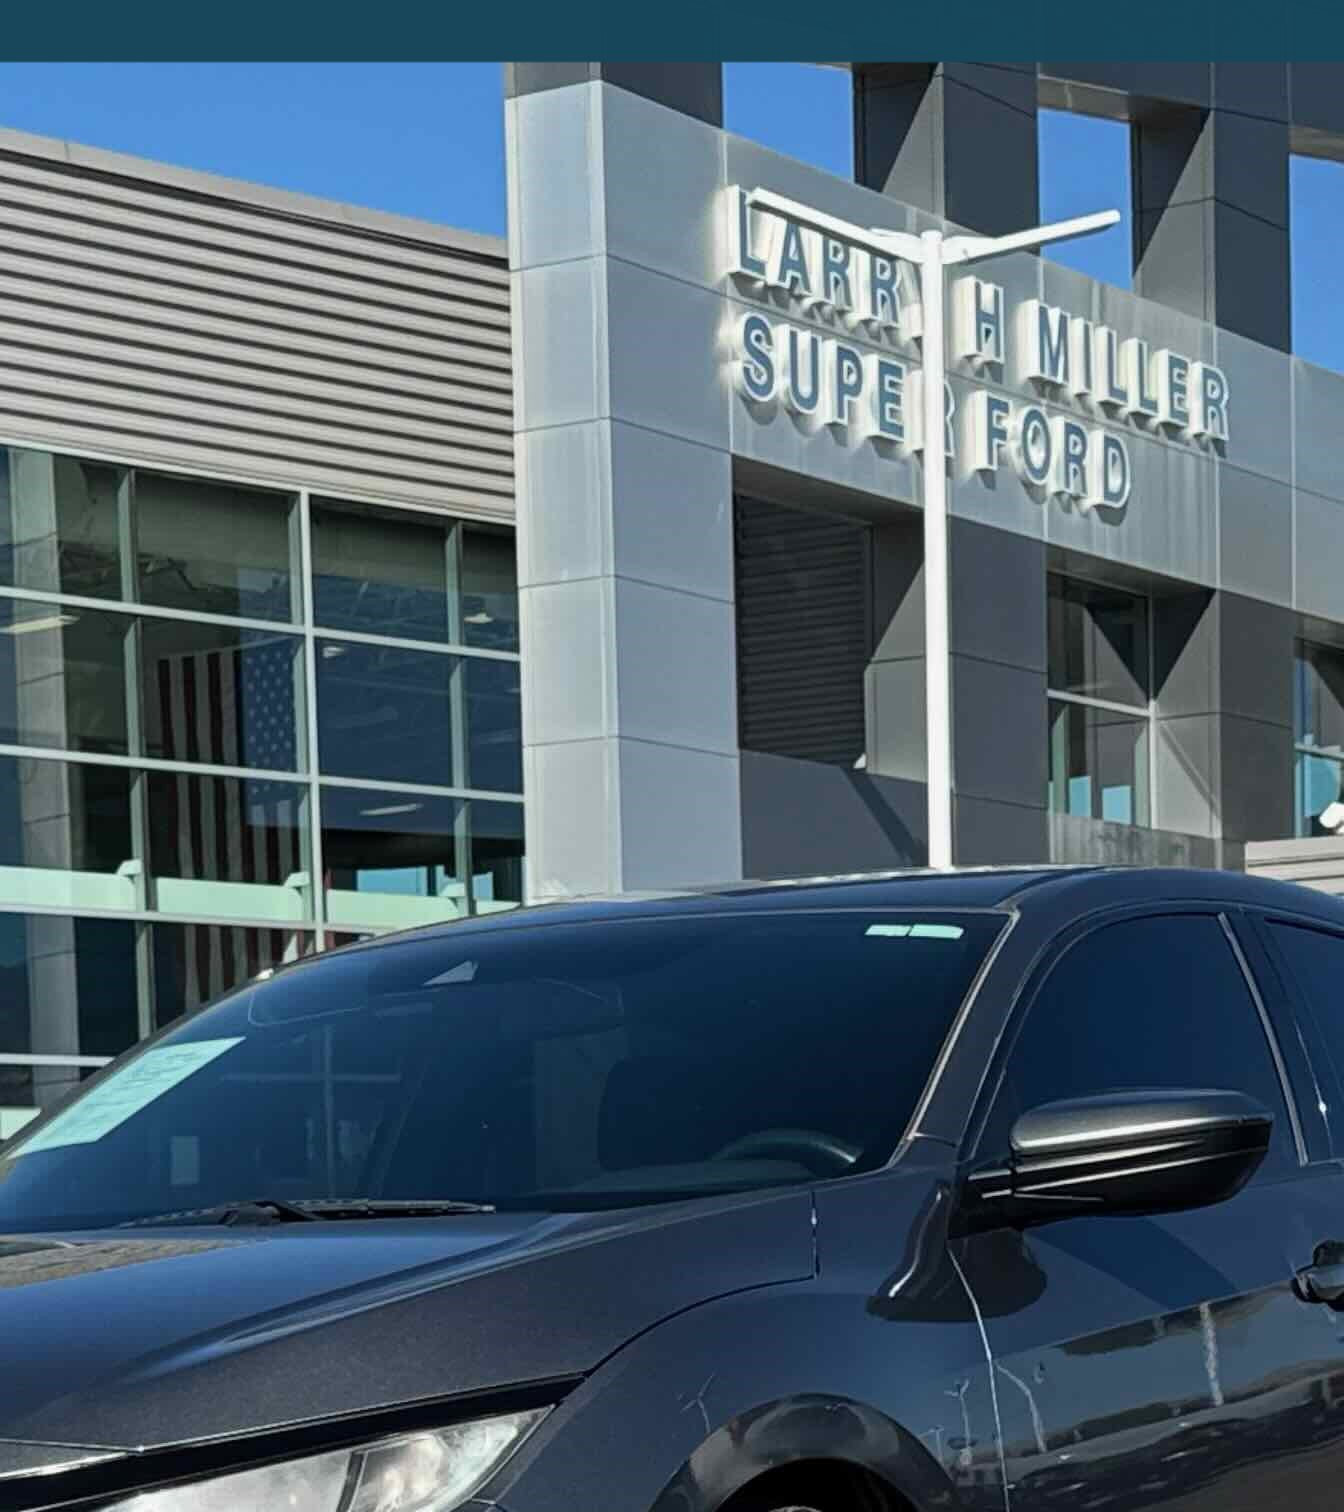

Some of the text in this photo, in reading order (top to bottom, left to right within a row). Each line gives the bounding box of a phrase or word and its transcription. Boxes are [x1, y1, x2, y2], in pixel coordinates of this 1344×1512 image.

[729, 184, 1230, 441] LARR H MILLER
[736, 310, 1131, 509] SUPE FORD
